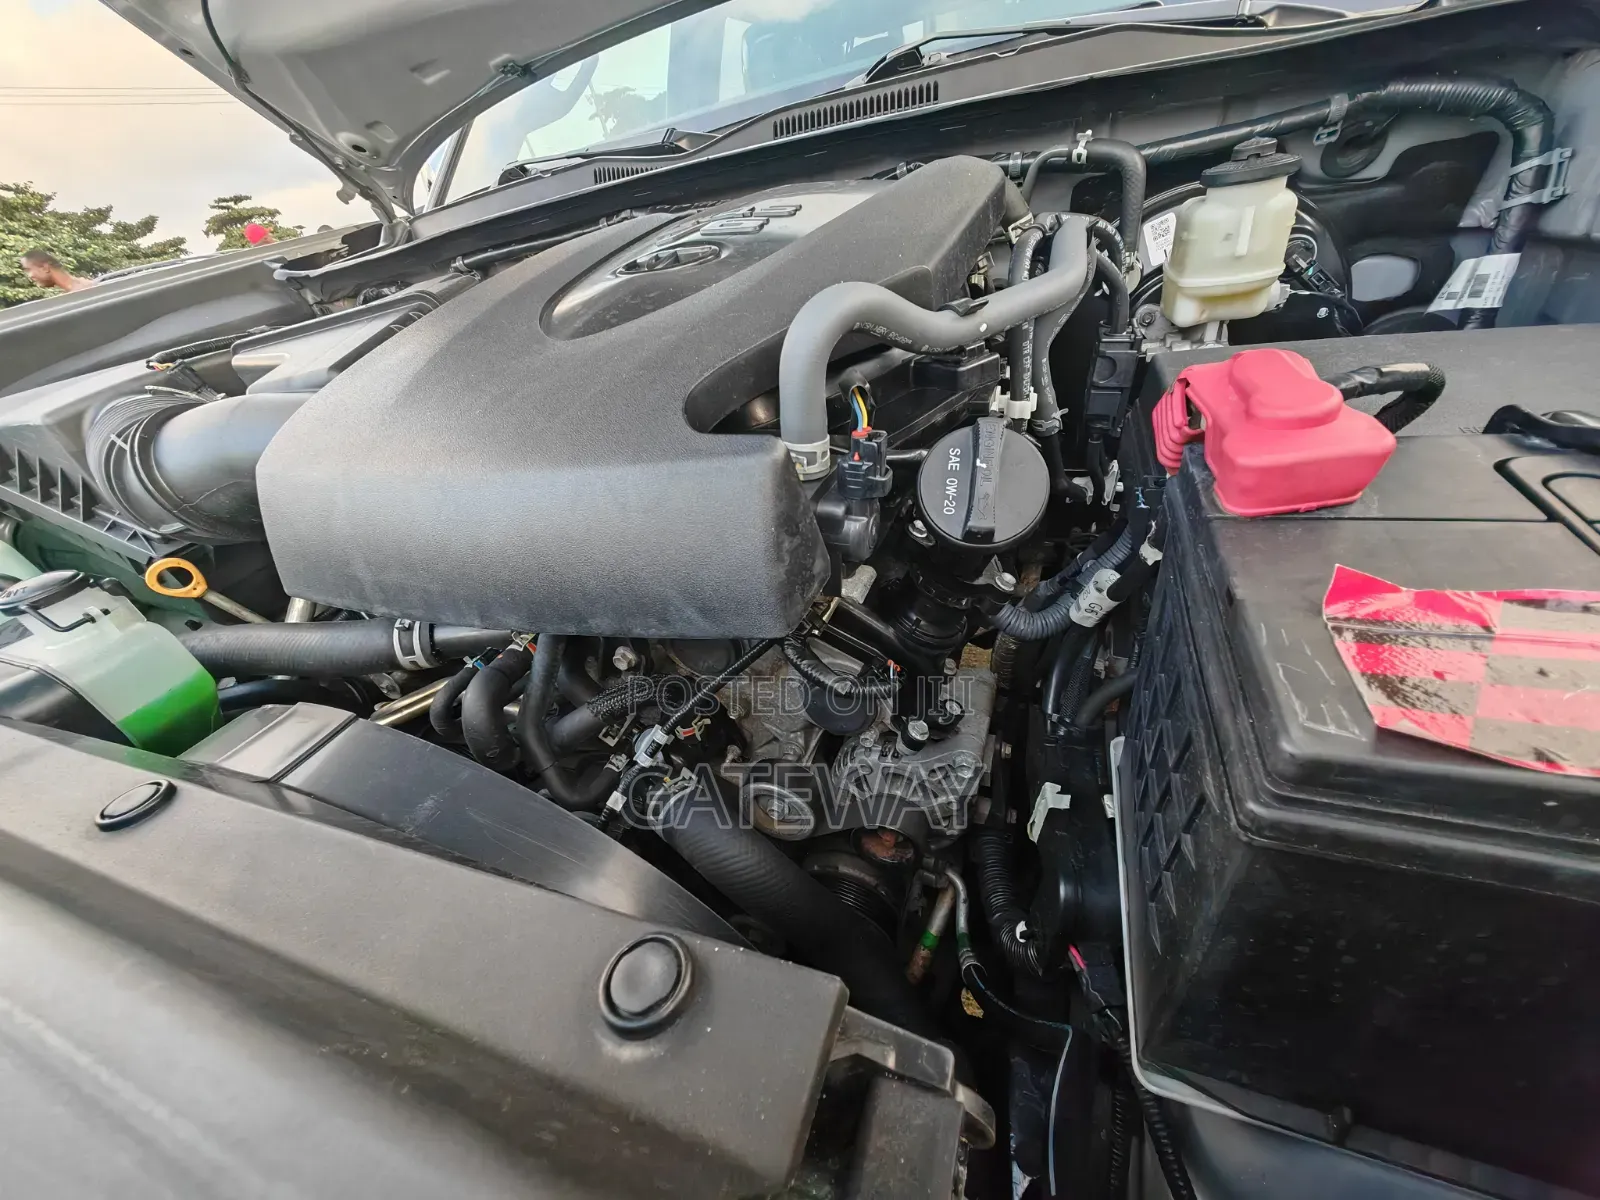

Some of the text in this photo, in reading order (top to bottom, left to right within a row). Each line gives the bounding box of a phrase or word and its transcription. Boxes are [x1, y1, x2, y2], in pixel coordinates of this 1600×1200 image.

[943, 447, 961, 515] SAE 0W-20
[980, 422, 999, 487] ENGINE OIL
